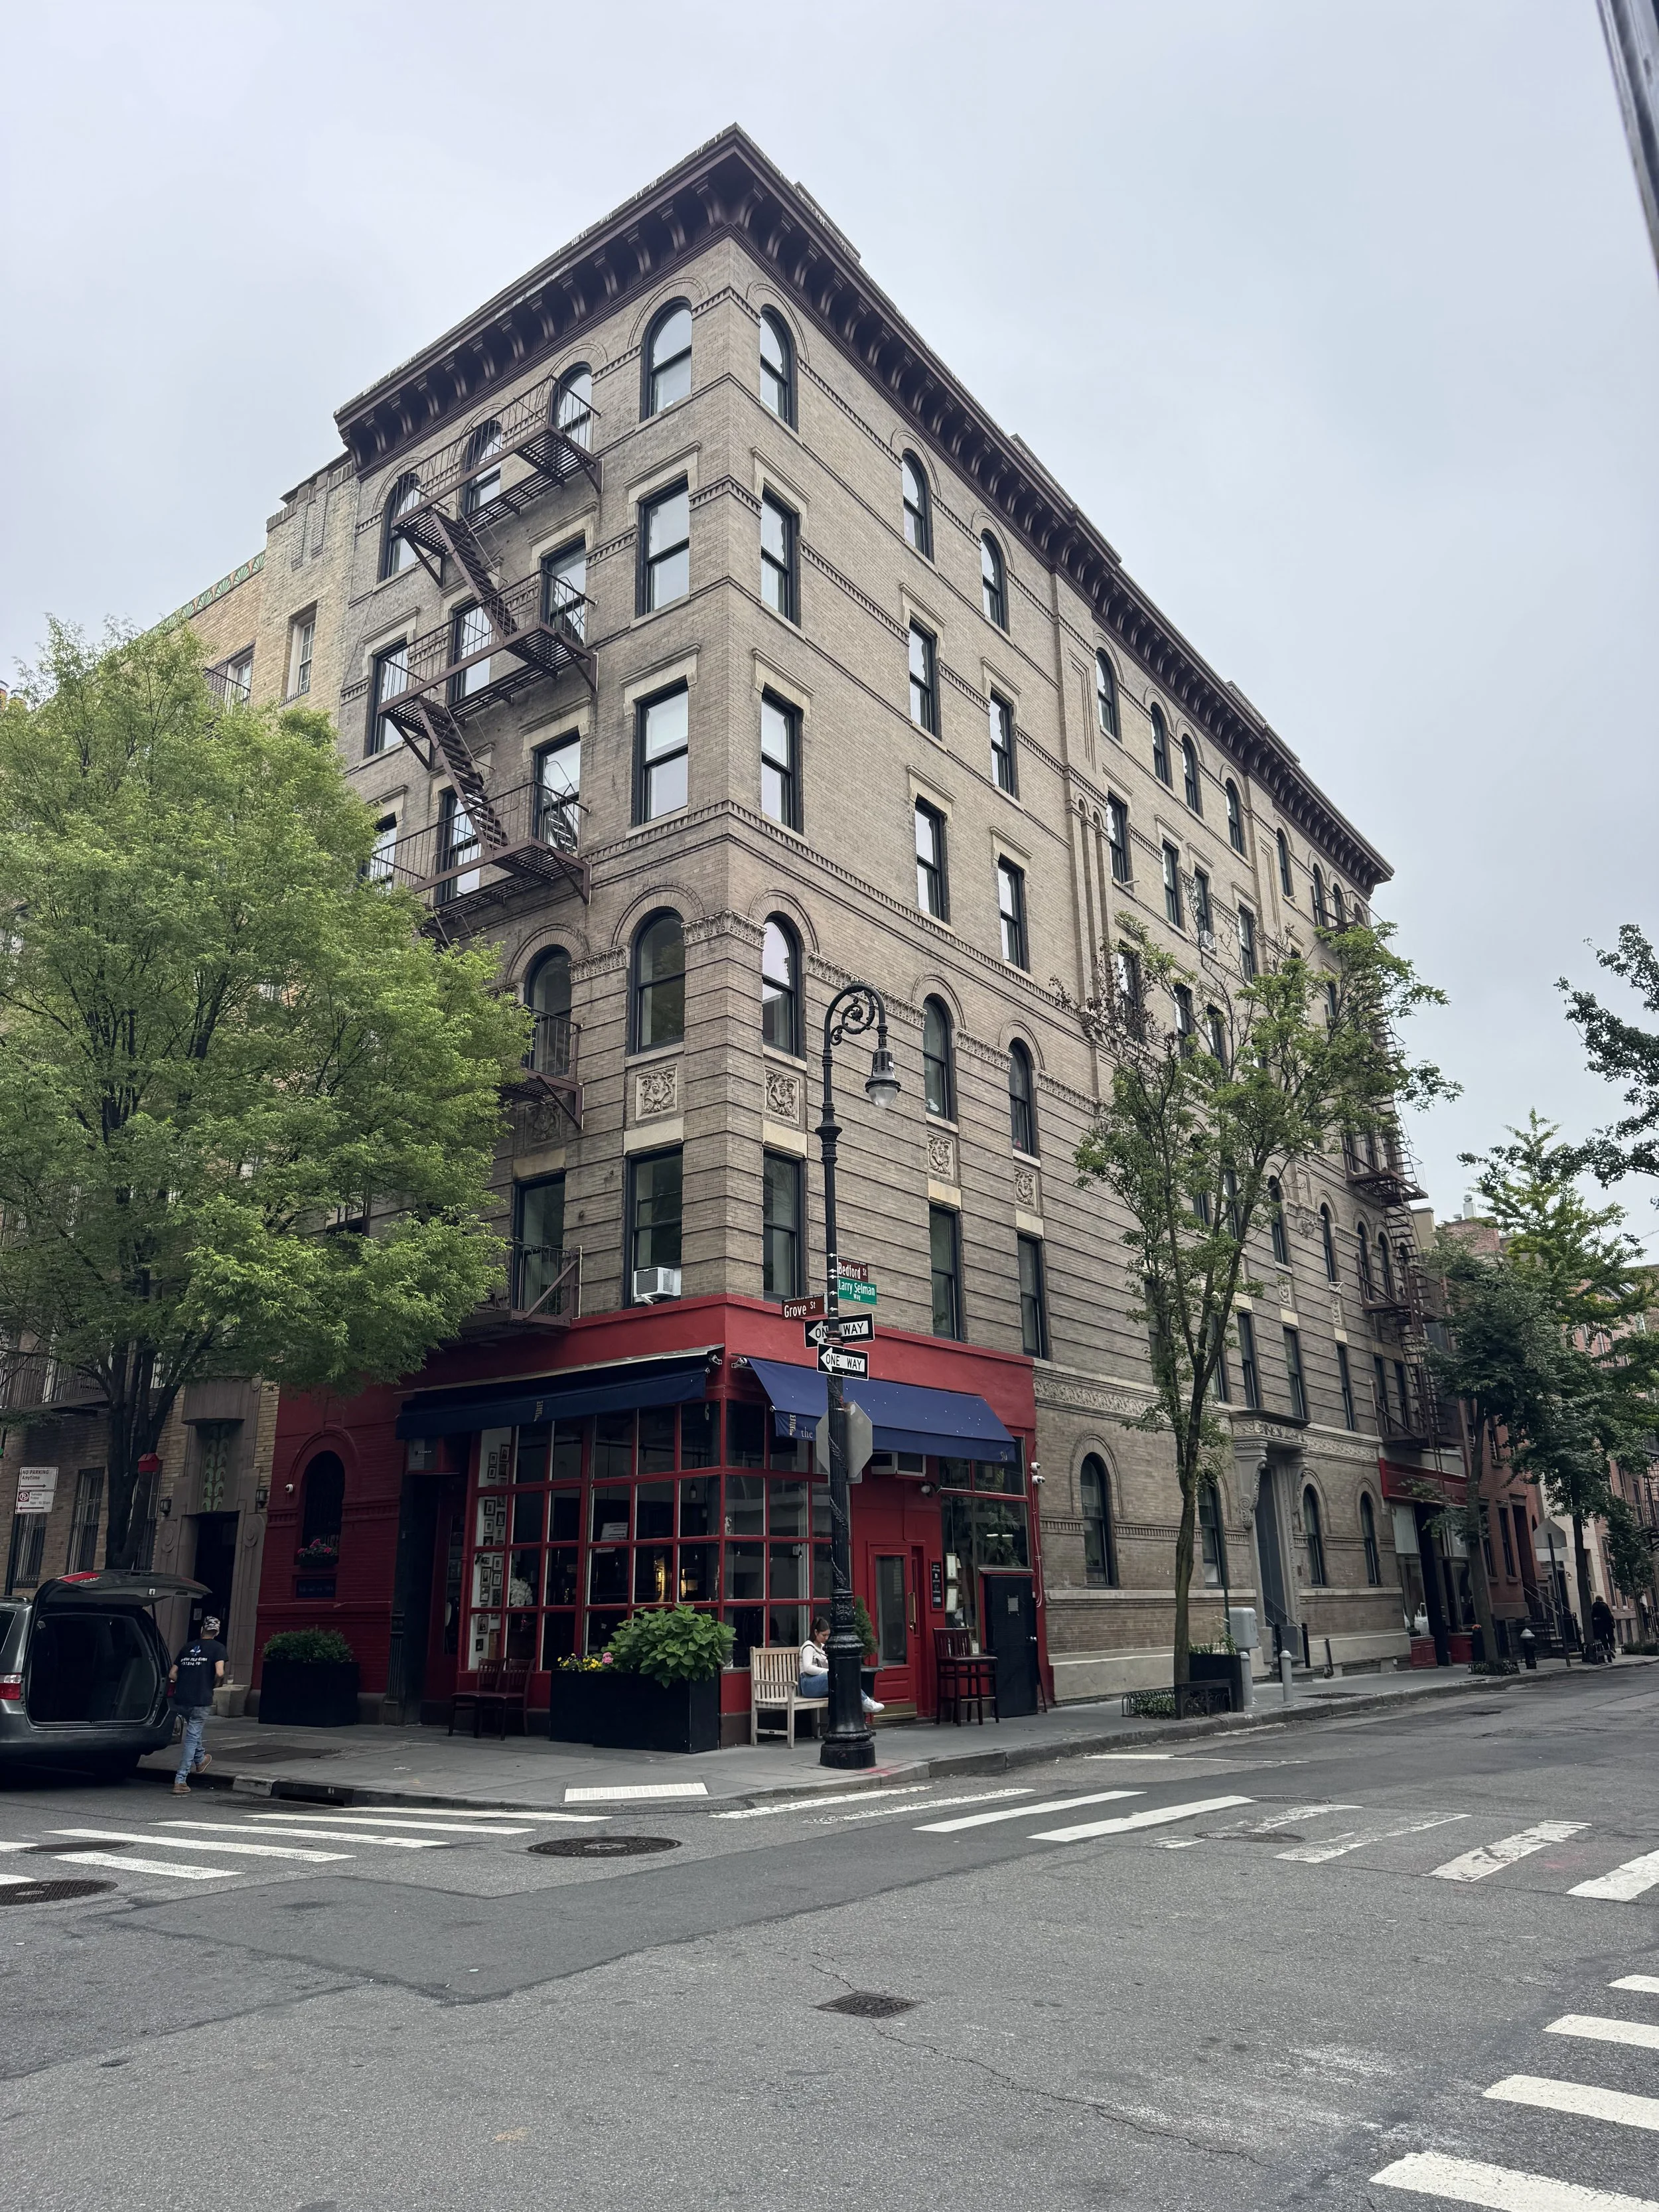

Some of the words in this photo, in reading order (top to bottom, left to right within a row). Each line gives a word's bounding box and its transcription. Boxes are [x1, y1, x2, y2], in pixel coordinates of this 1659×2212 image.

[838, 1262, 861, 1279] Bedford
[863, 1268, 867, 1276] St
[839, 1280, 853, 1294] Larry
[854, 1282, 875, 1295] Selman
[784, 1305, 807, 1318] Grove
[810, 1301, 816, 1309] St
[815, 1327, 828, 1339] ON
[843, 1322, 864, 1335] WAY
[826, 1353, 841, 1366] ONE
[847, 1357, 862, 1370] WAY
[801, 1426, 813, 1438] the
